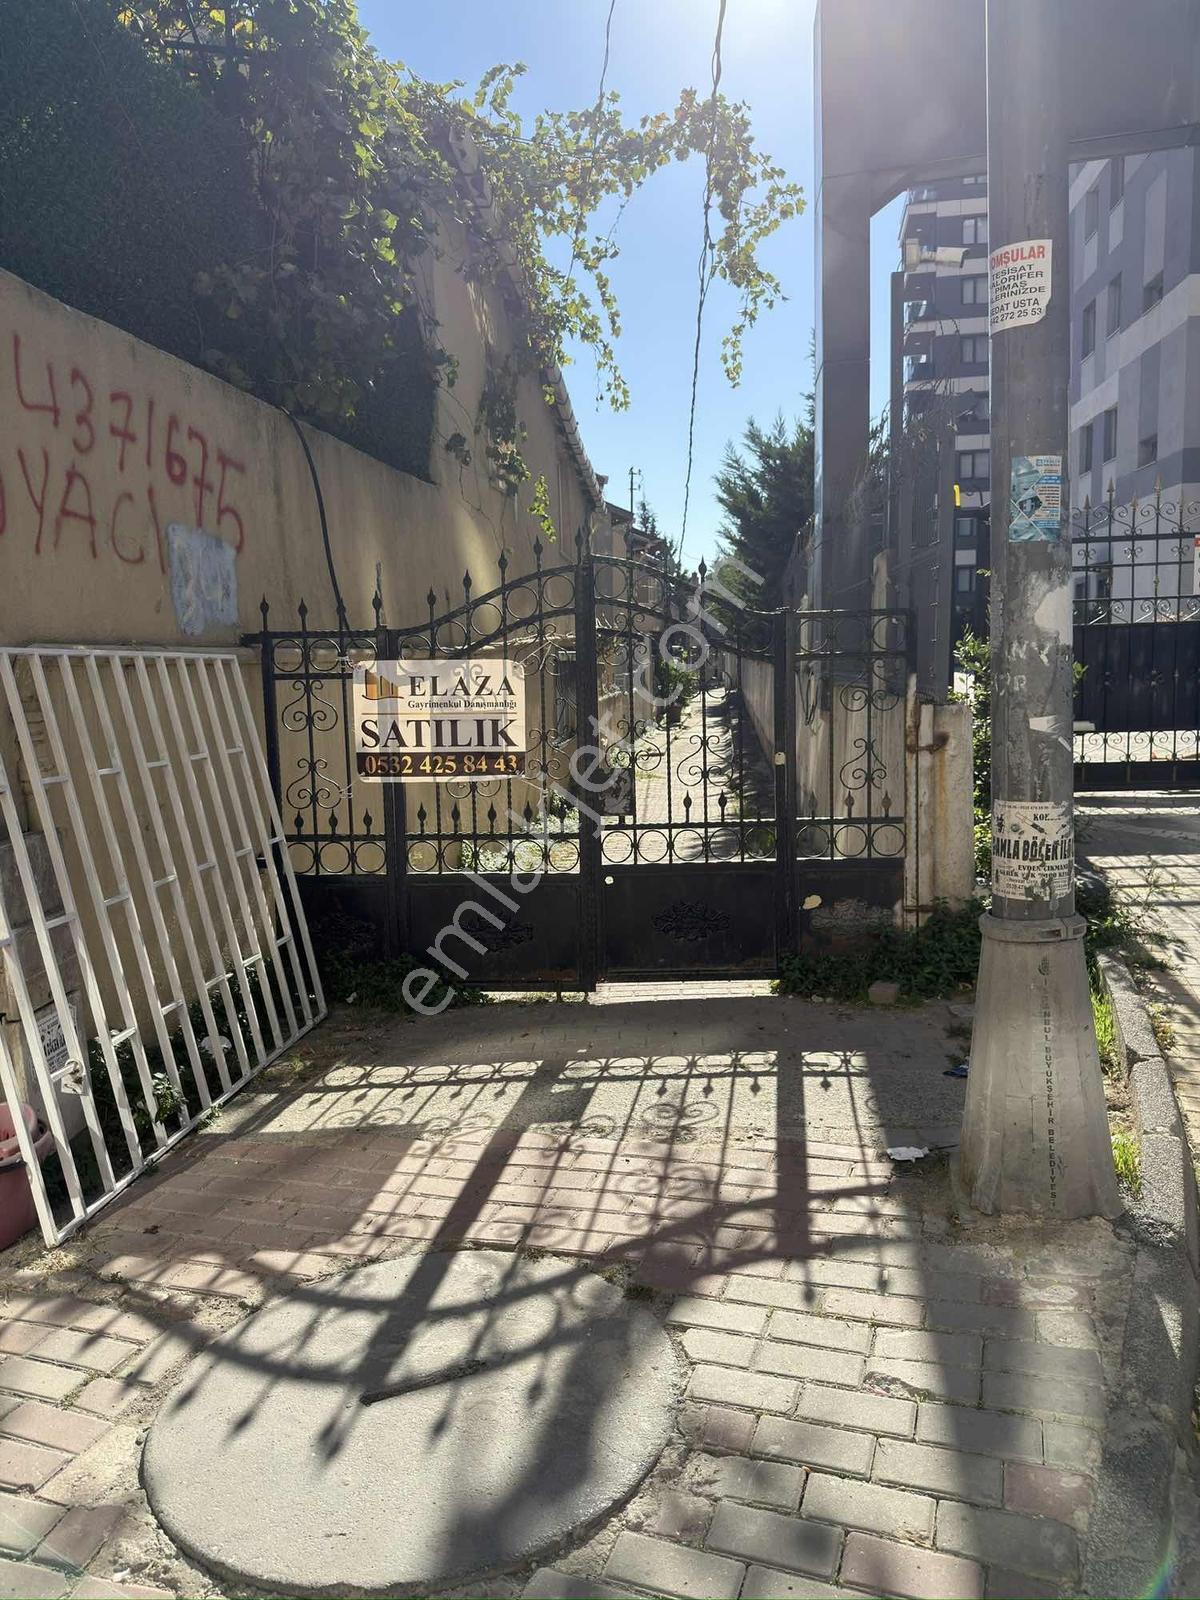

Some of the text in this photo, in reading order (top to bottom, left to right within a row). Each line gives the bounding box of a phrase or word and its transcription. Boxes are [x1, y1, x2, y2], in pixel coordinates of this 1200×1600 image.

[1013, 298, 1040, 309] USTA
[1001, 312, 1015, 322] 272
[1017, 309, 1028, 318] 25
[1031, 308, 1042, 316] 53
[0, 446, 166, 574] YACI
[408, 675, 515, 696] ELAZA
[408, 700, 461, 710] Gayrimenkul
[361, 719, 519, 748] SATILIK
[365, 755, 517, 774] 0532 425 84 43
